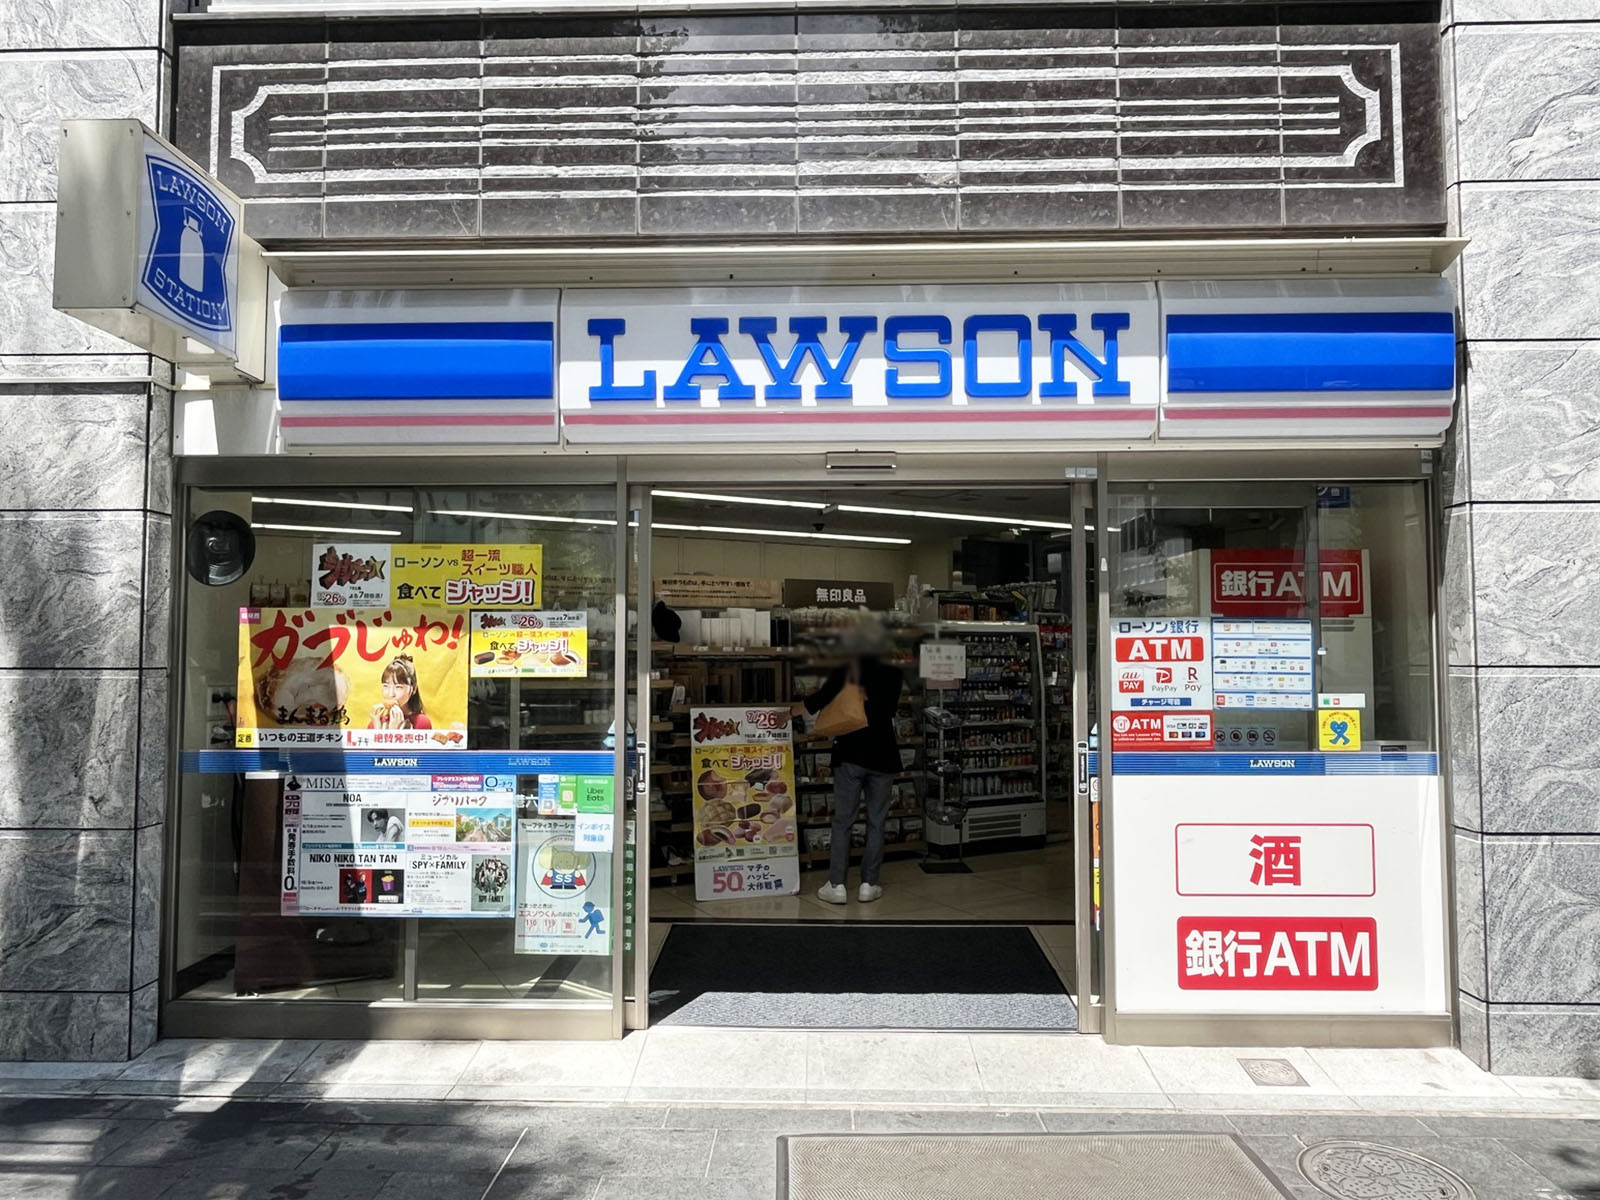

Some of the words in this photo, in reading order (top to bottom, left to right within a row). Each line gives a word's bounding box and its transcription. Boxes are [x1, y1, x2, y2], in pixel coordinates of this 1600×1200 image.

[156, 170, 227, 235] LAWSON
[154, 267, 227, 320] STATION
[587, 312, 1131, 401] LAWSON
[461, 549, 501, 562] 超一流
[394, 557, 445, 569] ローソン
[461, 563, 538, 576] スイーツ職人
[1220, 569, 1352, 598] 銀行AM
[397, 582, 442, 600] 食べて
[446, 579, 533, 604] ジャッジ!
[815, 587, 867, 604] 無印良品
[1119, 620, 1199, 634] ローソン銀行
[489, 640, 516, 651] 食べて
[517, 639, 569, 654] ジャッジ!
[1128, 639, 1193, 660] ATM
[1121, 671, 1141, 680] au
[1187, 666, 1199, 681] R
[1122, 682, 1141, 690] PAY
[1151, 685, 1178, 693] PayPay
[1184, 684, 1202, 693] Pay
[1131, 718, 1161, 730] ATM
[258, 731, 344, 743] いつもの王道チキン
[373, 732, 429, 744] 絶賛発売中!
[373, 757, 418, 767] LAWSON
[507, 757, 551, 767] LAWSON
[701, 757, 730, 769] 食べて
[730, 754, 784, 771] ジャッジ!
[1249, 759, 1296, 768] LAWSON
[305, 777, 346, 789] MISIA
[586, 787, 604, 795] Uber
[342, 793, 362, 803] NOA
[432, 794, 488, 807] ジブリパーク
[577, 823, 612, 831] インボイス
[309, 854, 331, 863] NIKO
[334, 854, 355, 863] NIKO
[357, 854, 377, 863] TAN
[379, 854, 397, 863] TAN
[1248, 833, 1302, 887] 酒
[411, 860, 467, 870] SPY×FAMILY
[746, 863, 770, 872] マチの
[555, 874, 573, 883] SS
[746, 873, 776, 881] ハッピー
[1184, 928, 1371, 978] 銀行ATM
